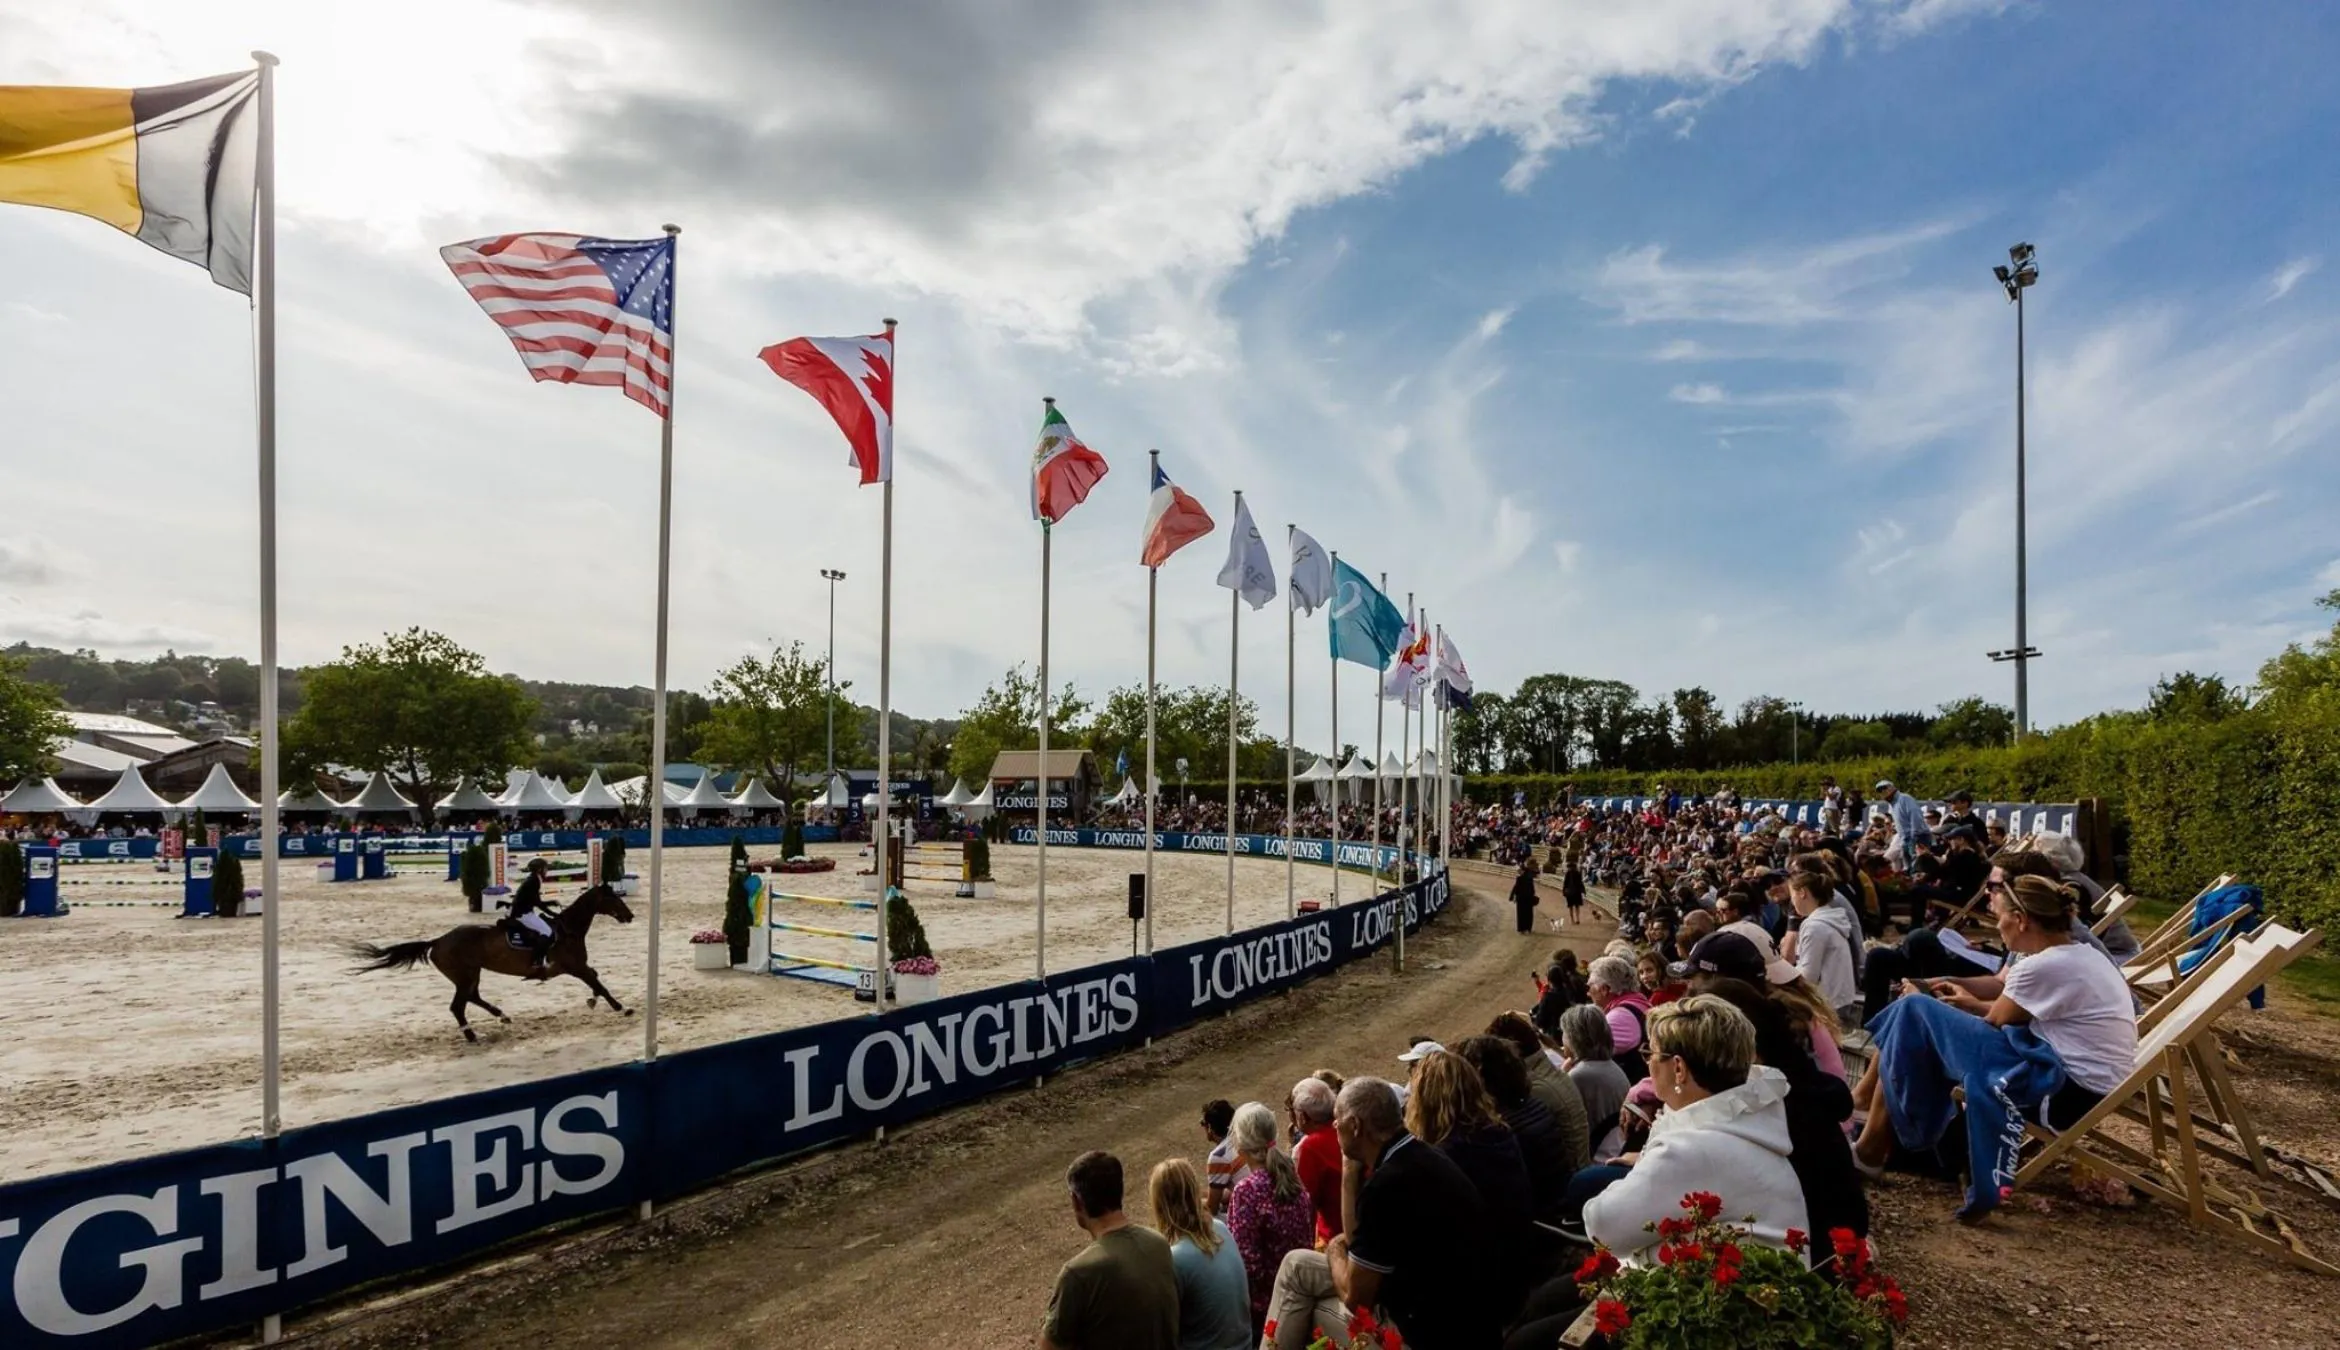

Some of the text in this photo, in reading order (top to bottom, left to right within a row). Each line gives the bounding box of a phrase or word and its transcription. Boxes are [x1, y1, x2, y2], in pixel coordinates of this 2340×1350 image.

[996, 796, 1068, 809] LONGIES
[1094, 831, 1164, 849] LONGINS
[860, 973, 871, 988] 13
[1189, 920, 1332, 1008] LONGINES
[784, 972, 1139, 1132] LONGINES
[0, 1091, 625, 1336] GINES
